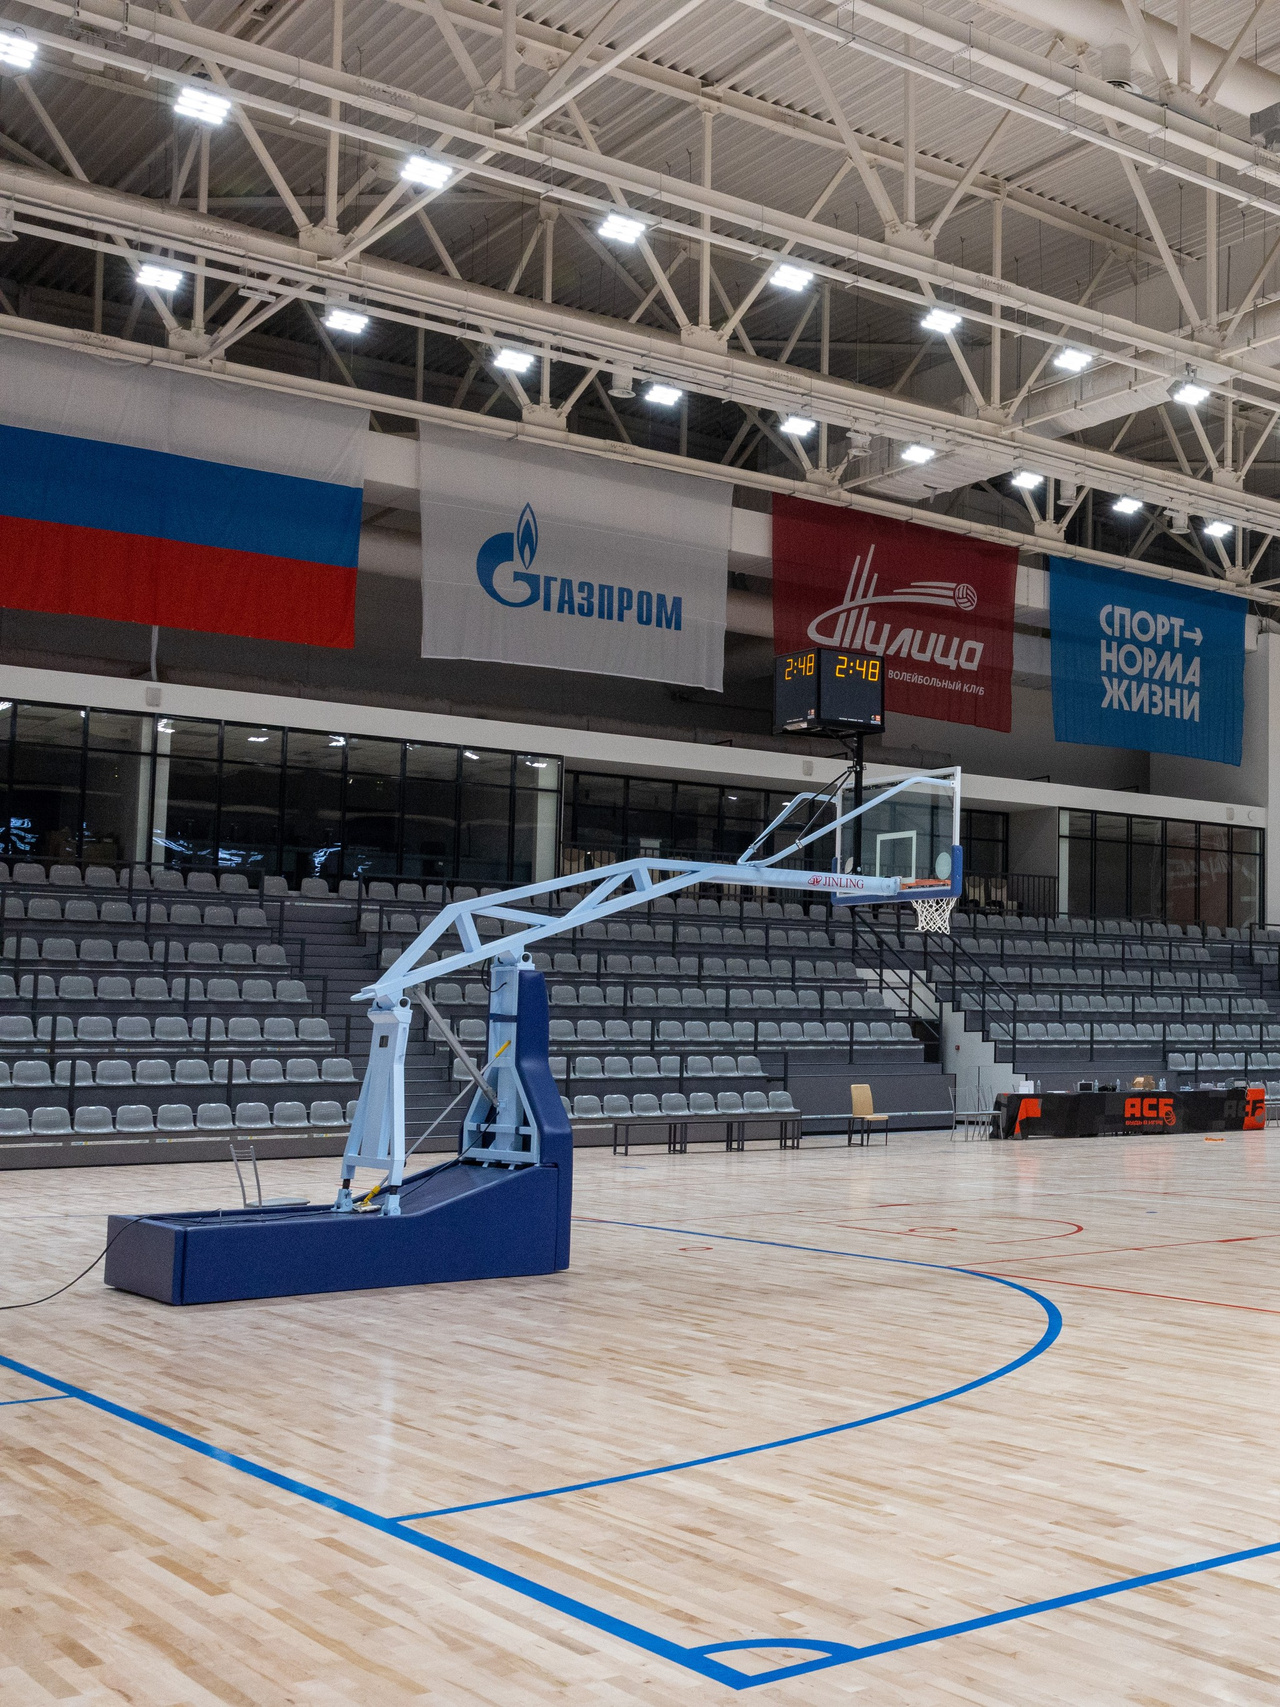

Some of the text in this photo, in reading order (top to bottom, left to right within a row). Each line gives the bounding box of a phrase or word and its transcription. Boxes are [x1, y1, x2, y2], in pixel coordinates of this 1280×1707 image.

[543, 575, 683, 631] ГАЗПРОМ
[1100, 604, 1184, 648] СПОРТ
[785, 653, 815, 680] 2:48
[835, 656, 880, 681] 2:48
[888, 669, 962, 691] ВОЛЕЙБОЛЬНЫЙ
[1100, 639, 1200, 687] НОРМА
[1101, 676, 1200, 722] ЖИЗНИ
[823, 876, 864, 889] JINLING
